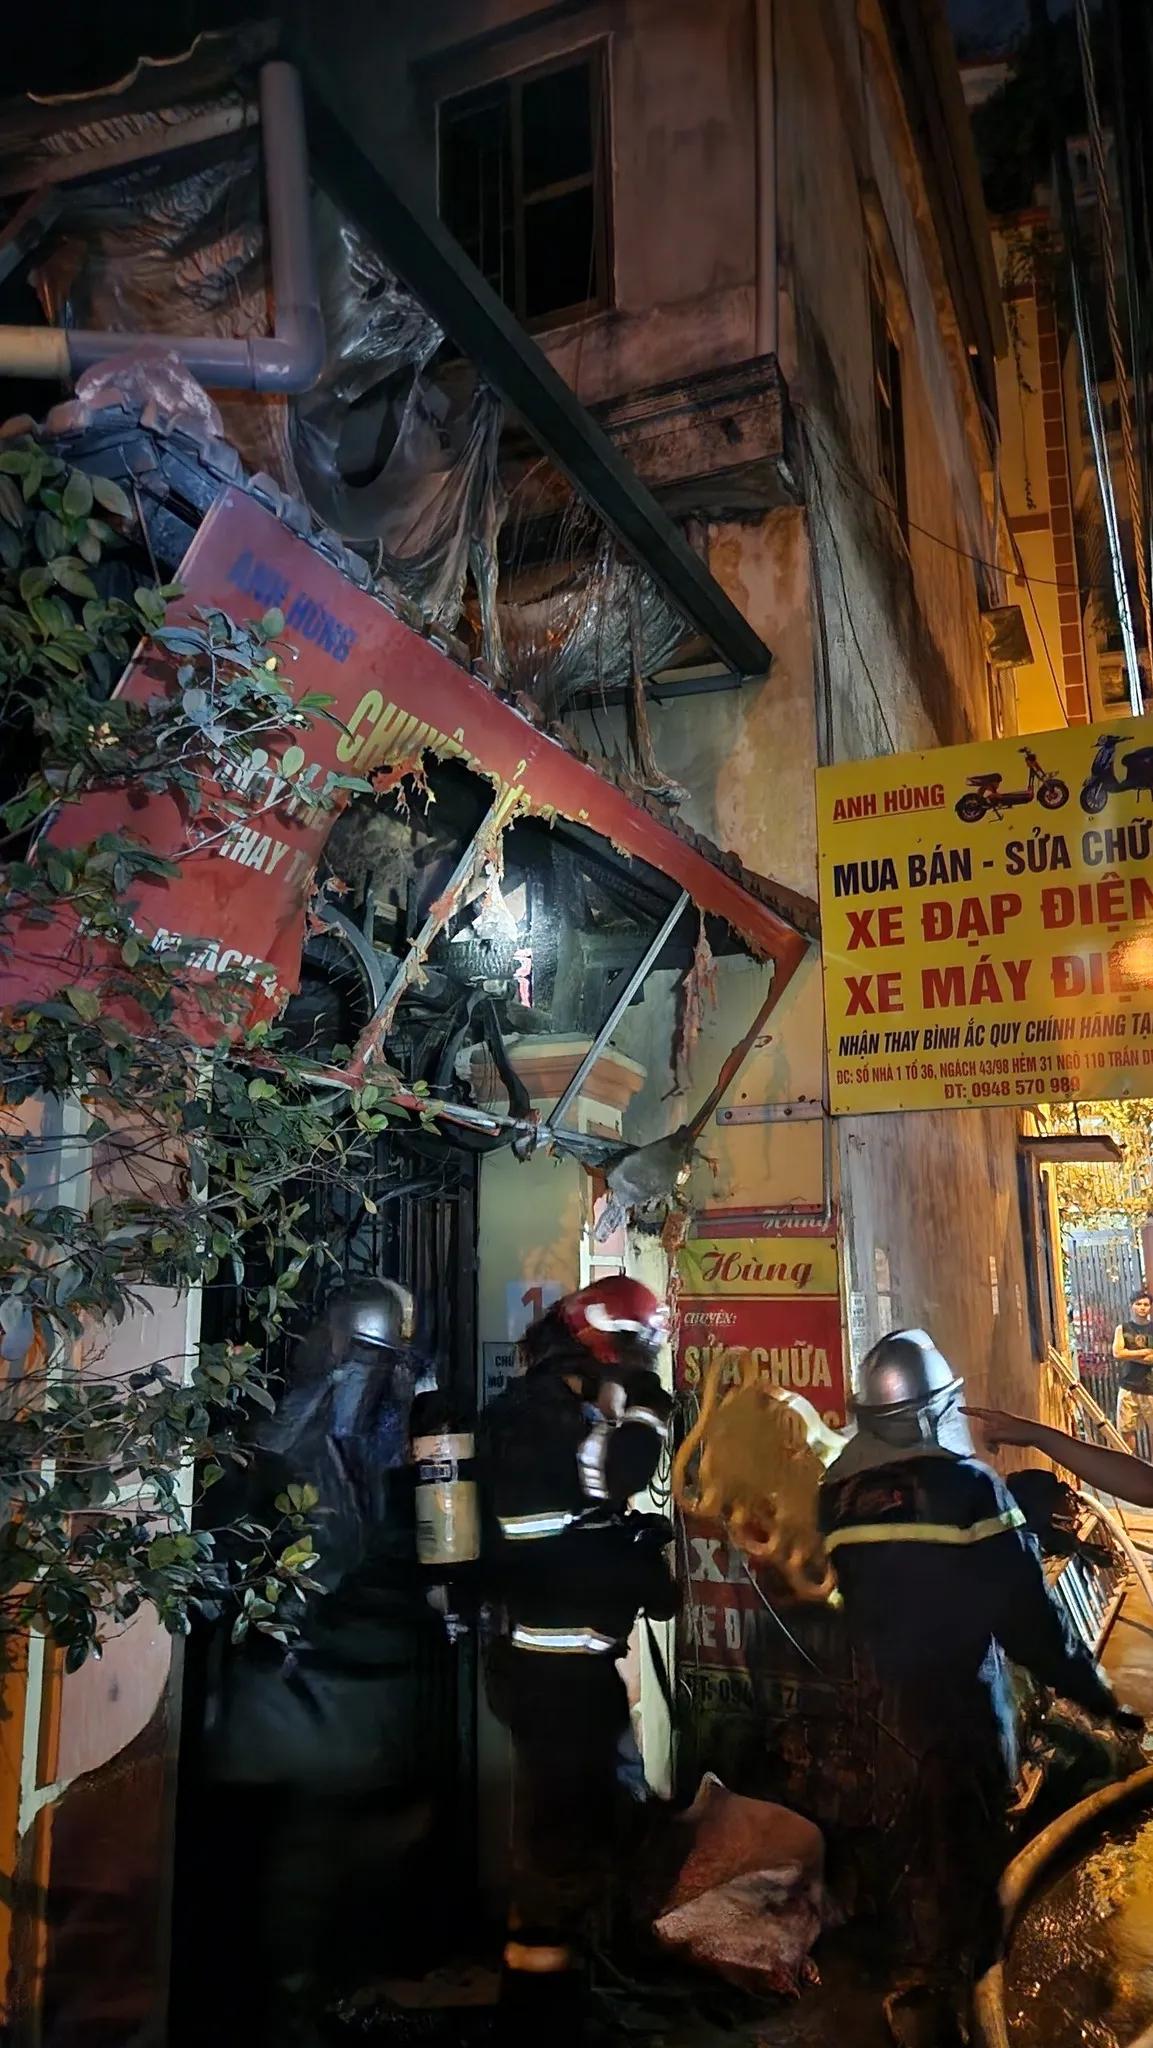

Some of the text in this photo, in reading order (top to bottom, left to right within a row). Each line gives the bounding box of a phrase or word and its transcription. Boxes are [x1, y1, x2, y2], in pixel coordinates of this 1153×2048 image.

[833, 784, 945, 821] ANH HÙNG
[833, 858, 899, 897] MUA
[908, 844, 972, 888] BÁN
[1005, 826, 1072, 876] SỬA
[846, 871, 1153, 951] XE ĐẠP ĐIỆN
[844, 973, 905, 1017] XE
[921, 953, 1032, 1010] MÁY
[838, 1011, 1153, 1060] NHẬN THAY BÌNH ẮC QUY CHÍNH HÃNG TẠ
[856, 1062, 870, 1084] SỐ
[896, 1065, 902, 1081] 1
[921, 1063, 937, 1080] 36,
[940, 1058, 977, 1078] NGÁCH
[979, 1058, 1009, 1076] 43/98
[1040, 1055, 1052, 1072] 31
[1084, 1052, 1105, 1069] 110
[944, 1083, 967, 1099] ĐT:
[971, 1081, 1010, 1098] 0948
[1015, 1078, 1045, 1094] 570
[751, 1340, 833, 1388] CHỮA
